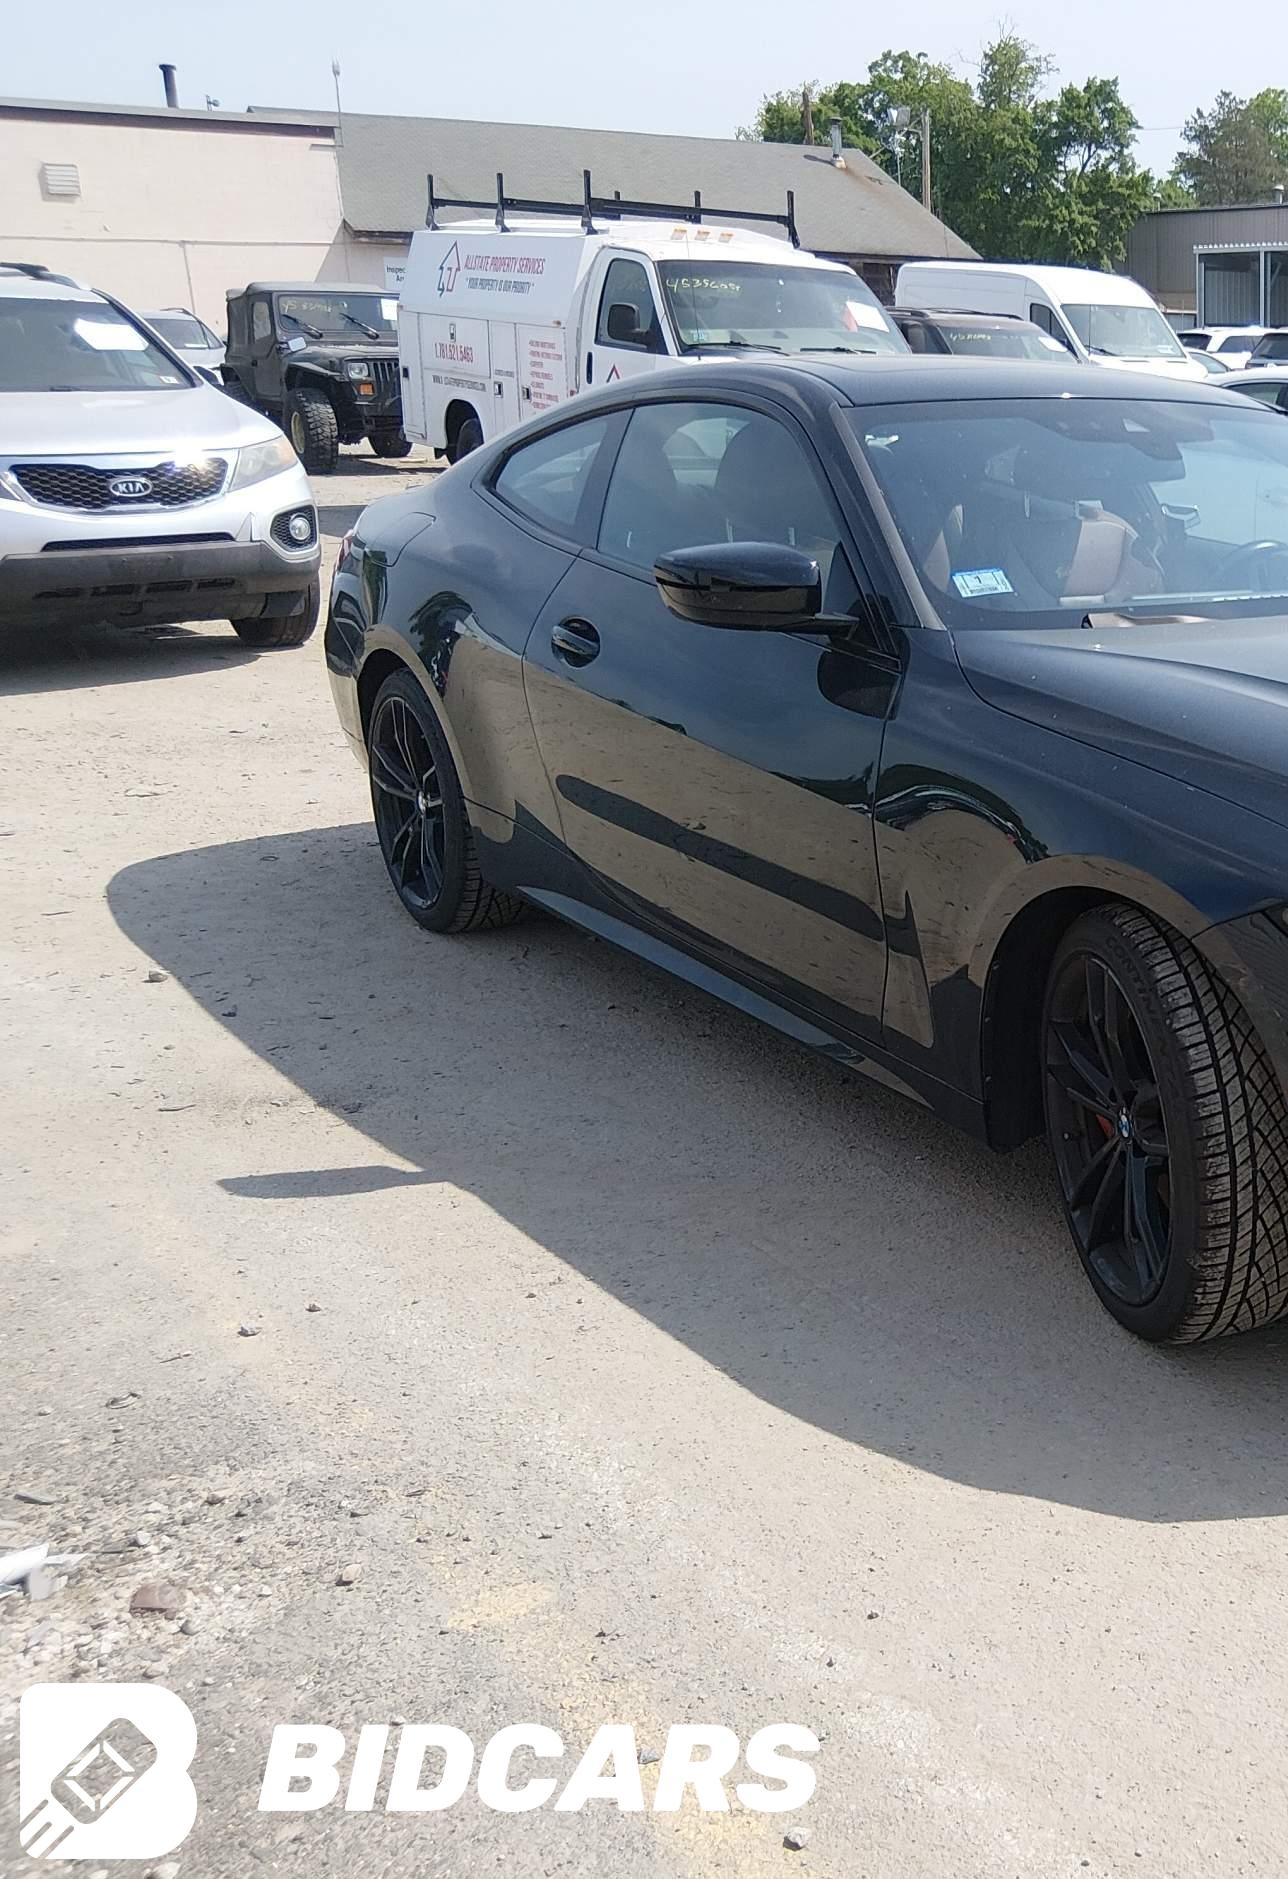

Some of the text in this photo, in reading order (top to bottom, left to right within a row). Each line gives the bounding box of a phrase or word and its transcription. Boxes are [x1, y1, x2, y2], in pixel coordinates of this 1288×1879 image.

[464, 255, 546, 275] ALLSTATE PROPERTY SERVICES
[479, 278, 498, 292] PROPERTY
[117, 482, 145, 493] KIA
